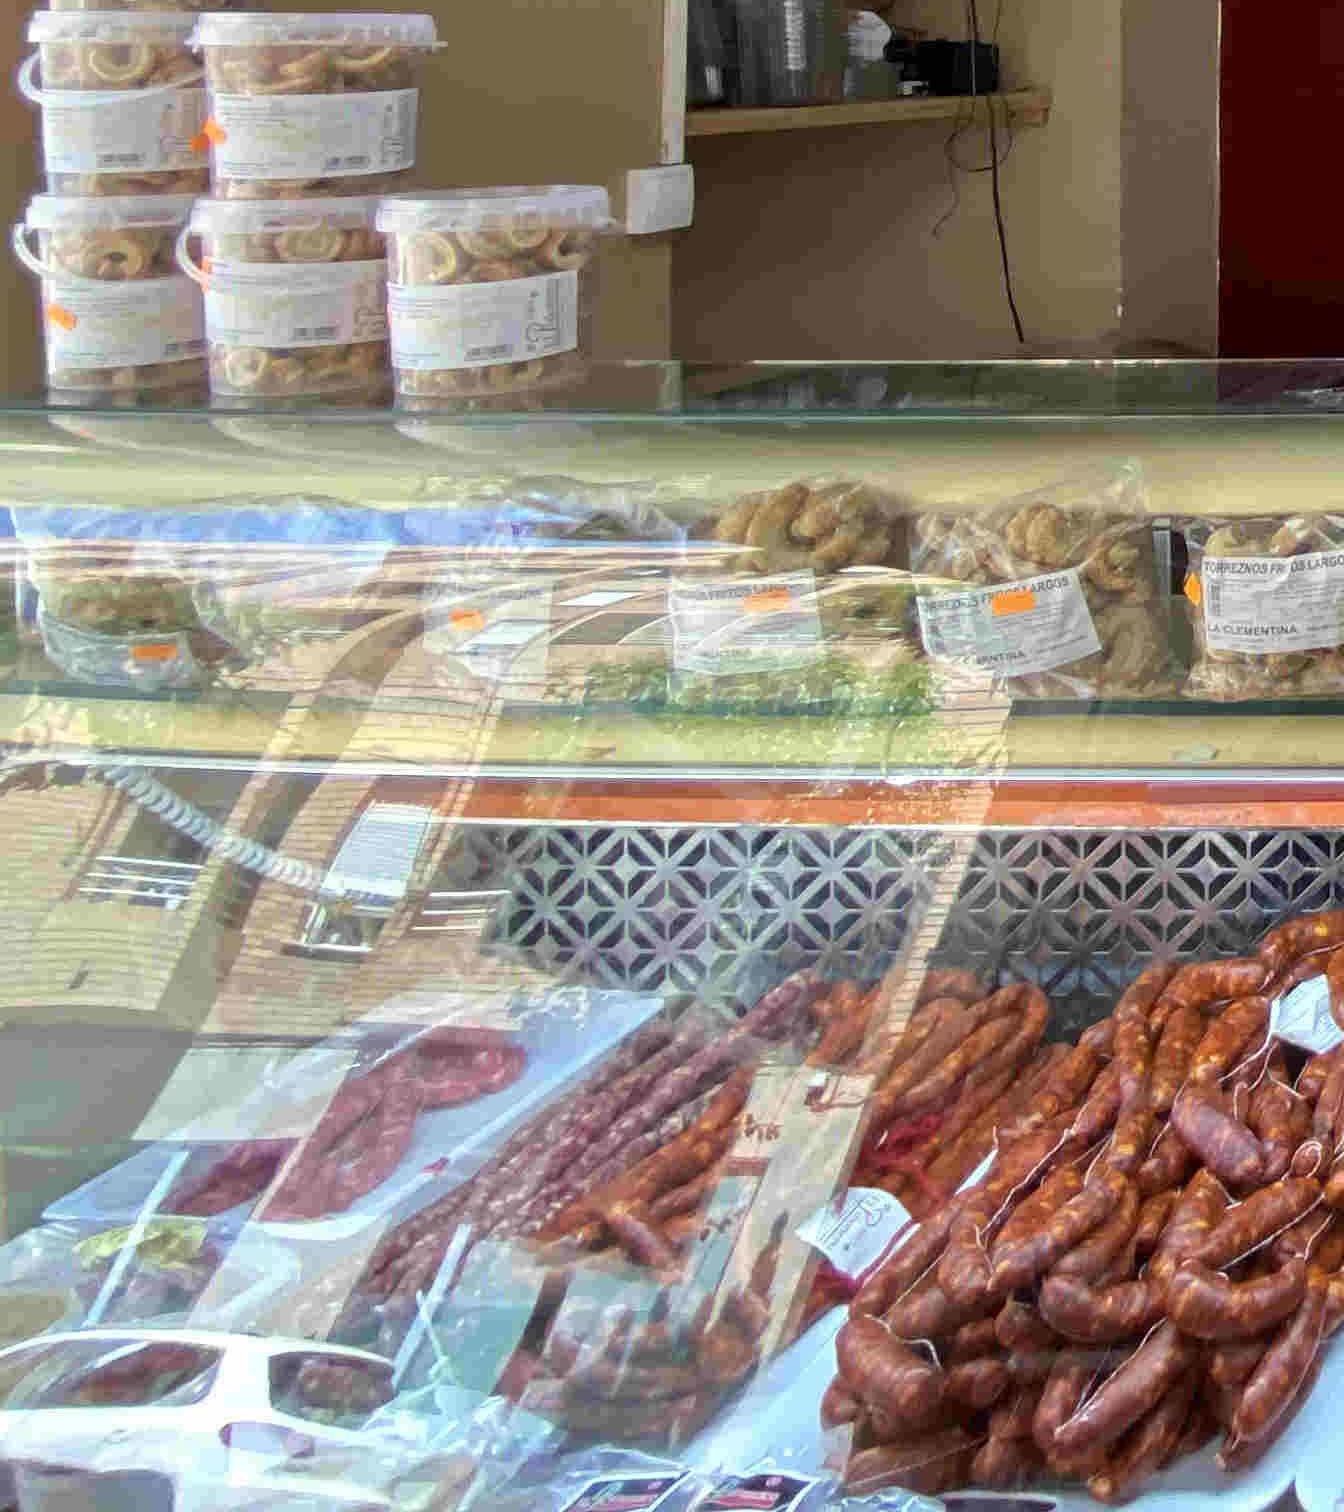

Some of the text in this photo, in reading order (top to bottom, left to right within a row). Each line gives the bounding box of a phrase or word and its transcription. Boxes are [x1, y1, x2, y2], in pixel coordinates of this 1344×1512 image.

[1270, 559, 1305, 574] FRIOS
[1026, 576, 1069, 592] ARGOS
[1223, 624, 1297, 636] CLEMENTINA
